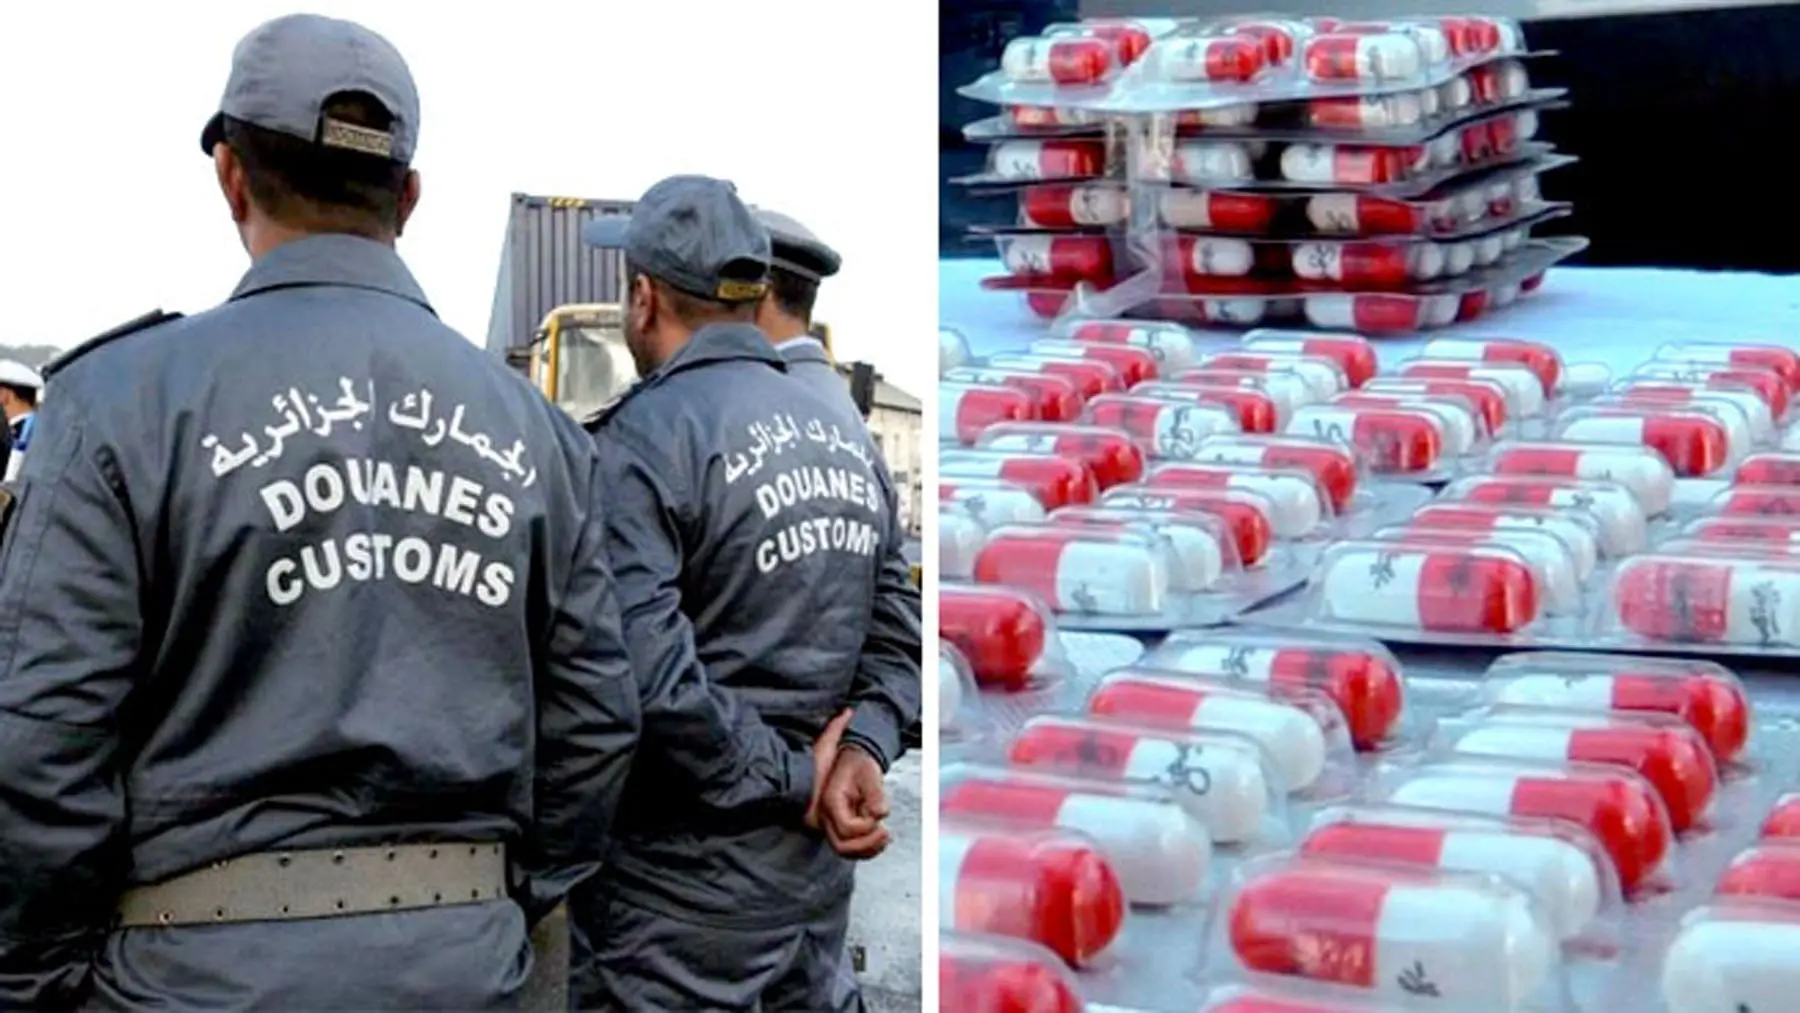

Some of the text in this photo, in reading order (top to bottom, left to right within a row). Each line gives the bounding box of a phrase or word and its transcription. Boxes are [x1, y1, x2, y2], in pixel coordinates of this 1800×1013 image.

[259, 459, 516, 538] DOUANES
[755, 465, 879, 520] DOUANES
[265, 533, 516, 608] CUSTOMS
